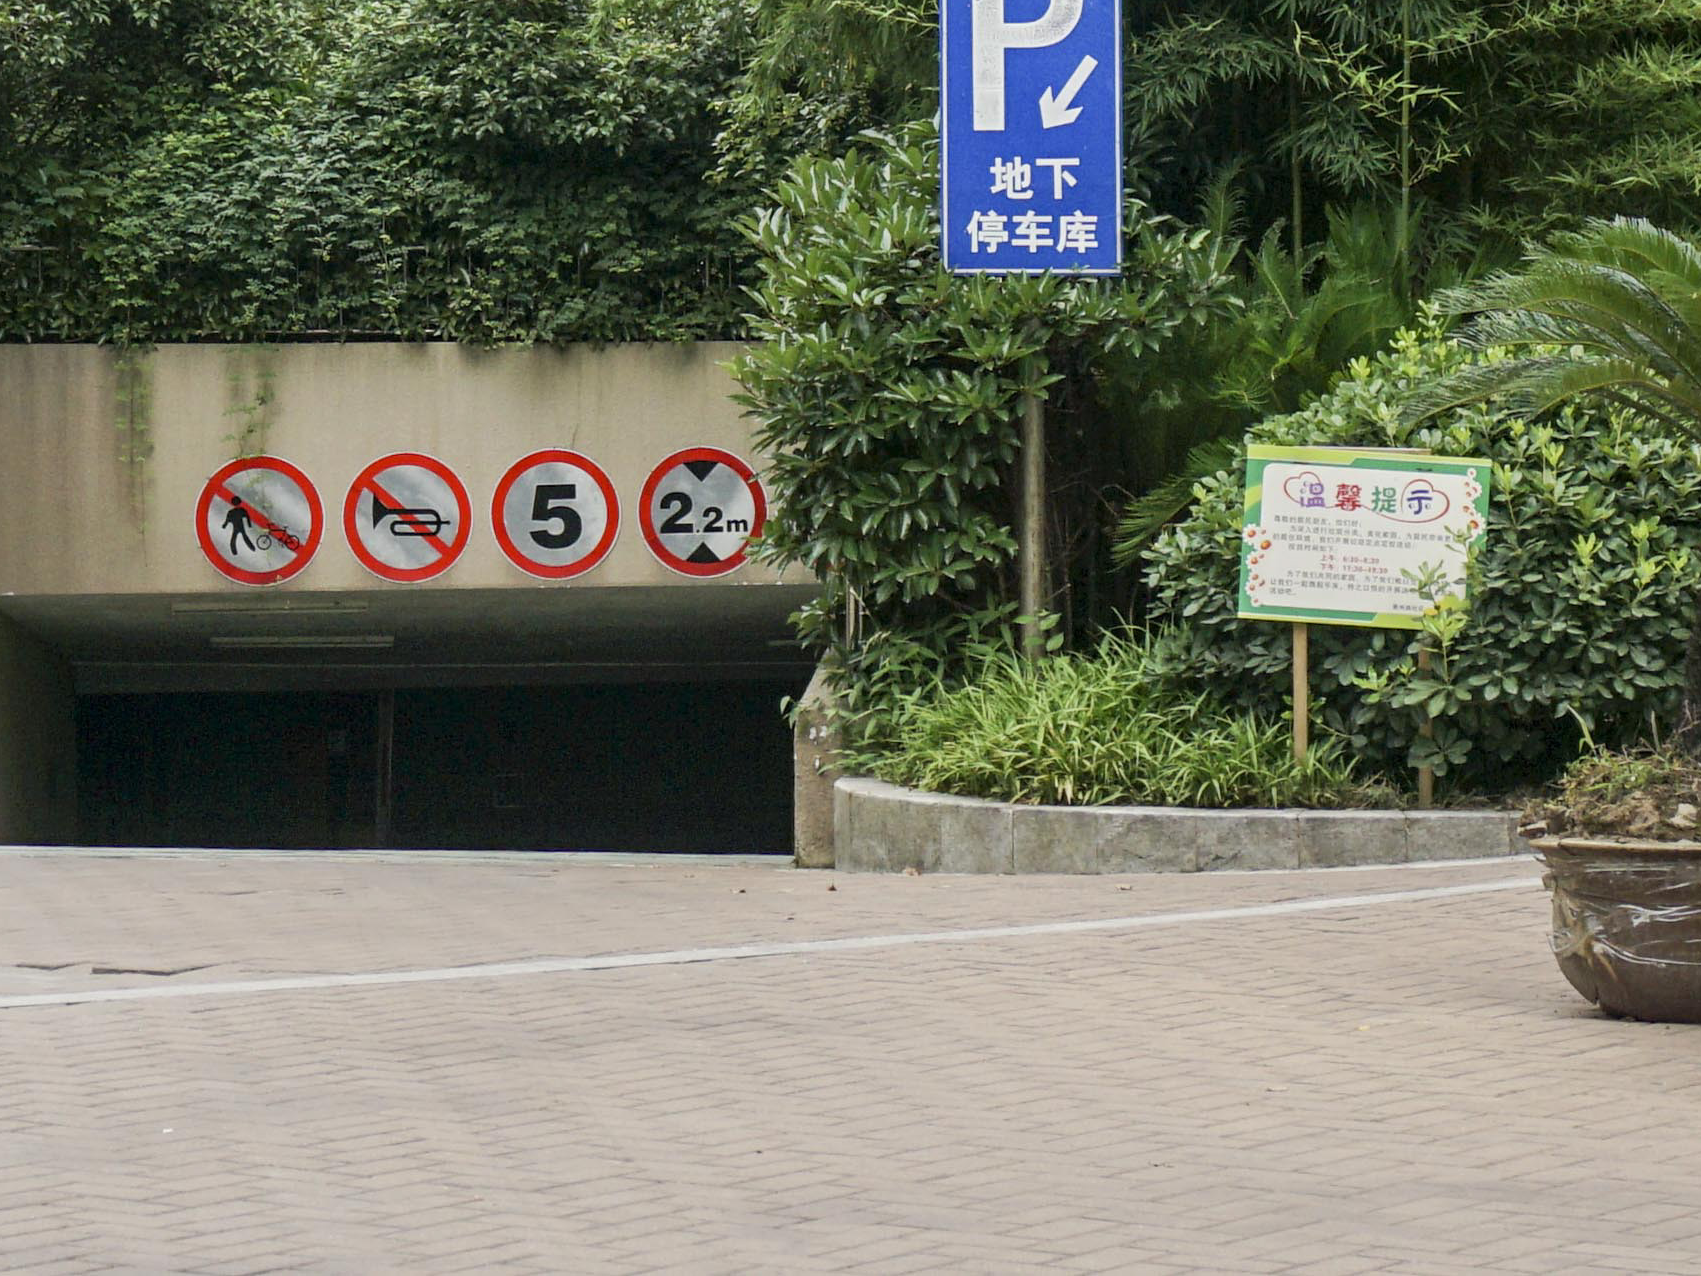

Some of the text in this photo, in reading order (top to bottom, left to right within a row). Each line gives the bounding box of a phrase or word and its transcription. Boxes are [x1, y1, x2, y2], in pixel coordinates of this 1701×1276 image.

[990, 157, 1080, 200] 地下
[967, 210, 1098, 254] 停车库
[529, 483, 582, 549] 5
[659, 491, 749, 535] 2.2m
[1299, 480, 1433, 515] 温馨提示
